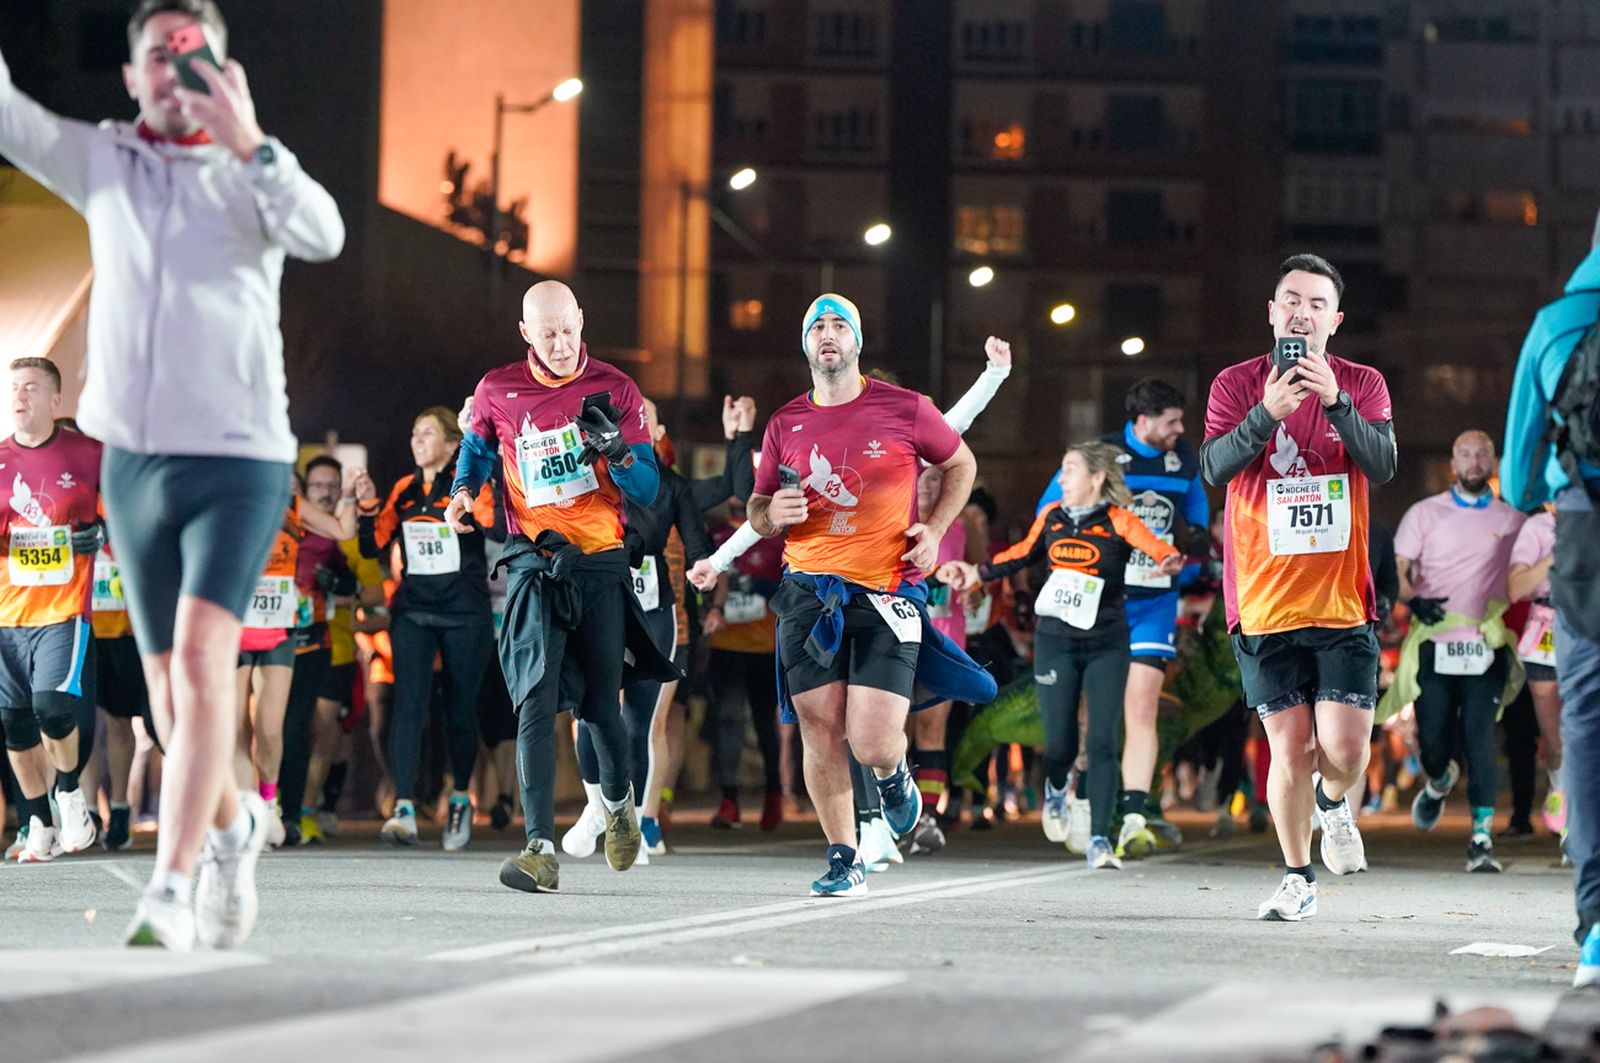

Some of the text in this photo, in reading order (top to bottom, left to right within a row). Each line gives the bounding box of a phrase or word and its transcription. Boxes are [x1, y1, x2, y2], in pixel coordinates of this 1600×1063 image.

[549, 437, 558, 445] DE
[824, 481, 841, 498] 43
[1286, 485, 1310, 494] NOCHE
[1311, 484, 1320, 493] DE
[1276, 495, 1292, 505] SAN
[1287, 503, 1334, 528] 7571
[19, 547, 62, 566] 5354
[252, 595, 282, 611] 7317
[1055, 588, 1083, 608] 956
